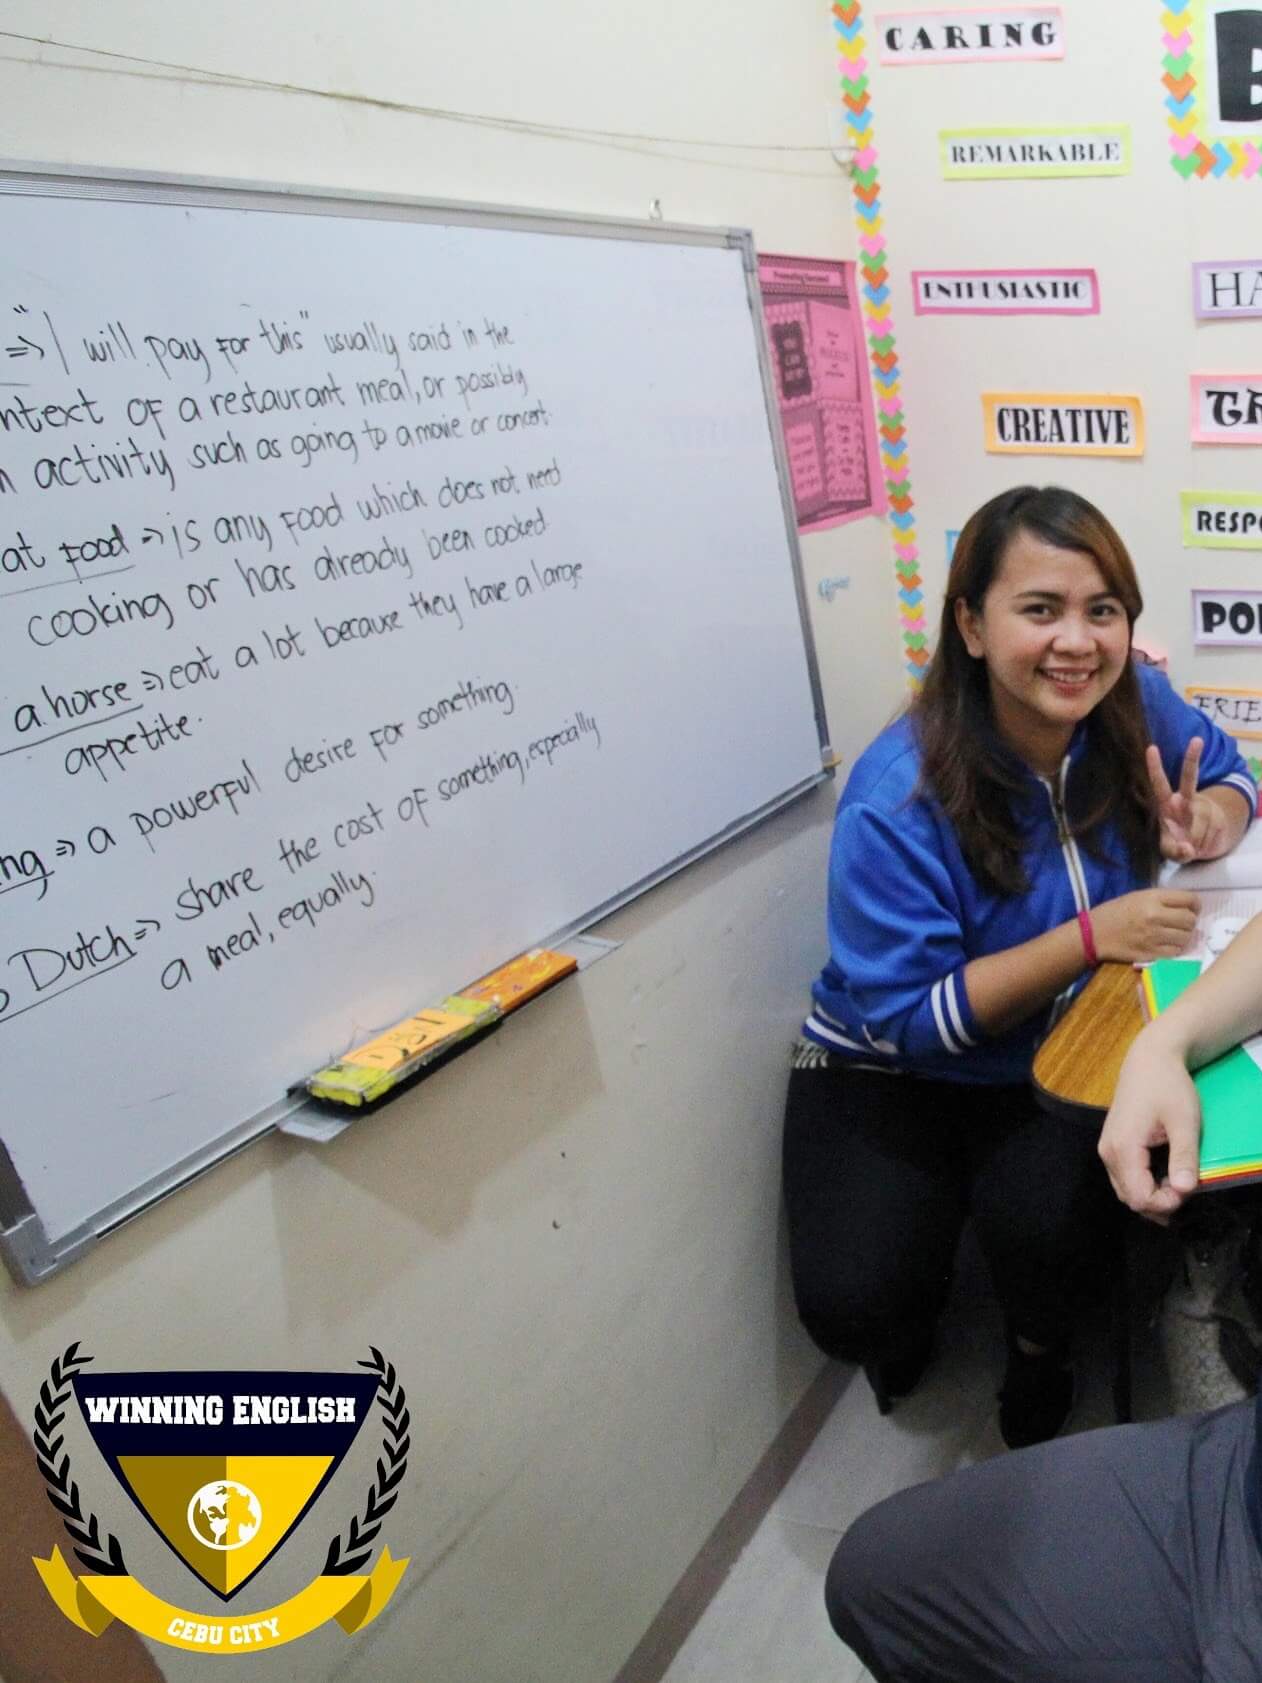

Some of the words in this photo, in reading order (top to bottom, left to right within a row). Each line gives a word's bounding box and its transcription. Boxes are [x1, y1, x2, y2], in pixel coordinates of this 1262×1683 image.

[884, 21, 1056, 51] CARING
[950, 142, 1120, 164] REMARKABLE
[922, 281, 1088, 300] ENTHUSIASTIC
[83, 320, 137, 363] will
[144, 334, 212, 384] pay
[324, 320, 401, 371] usually
[408, 322, 451, 352] said
[457, 319, 479, 347] in
[485, 316, 515, 350] the
[178, 396, 203, 423] a
[209, 371, 346, 418] restaurant
[455, 364, 528, 412] possibly
[996, 407, 1130, 445] CREATIVE
[34, 437, 176, 492] activity
[189, 430, 248, 470] such
[256, 437, 282, 460] as
[291, 421, 358, 468] going
[362, 418, 388, 451] to
[396, 424, 415, 448] a
[416, 412, 464, 443] movie
[471, 415, 489, 437] or
[166, 511, 201, 560] is
[213, 514, 273, 552] any
[356, 480, 428, 521] which
[438, 476, 486, 509] does
[526, 457, 562, 490] need
[28, 591, 175, 647] cooking
[186, 577, 220, 610] or
[234, 558, 297, 598] has
[313, 535, 415, 580] already
[421, 528, 476, 561] been
[41, 684, 132, 719] horse
[169, 645, 220, 690] eat
[234, 645, 259, 669] a
[261, 624, 306, 661] lot
[314, 610, 404, 649] because
[408, 591, 465, 631] they
[464, 575, 511, 609] have
[515, 575, 532, 598] a
[530, 559, 584, 591] large
[87, 826, 117, 854] a
[284, 737, 357, 784] desire
[8, 925, 136, 993] Dutch
[278, 836, 321, 875] the
[333, 801, 384, 848] cost
[160, 958, 193, 991] a
